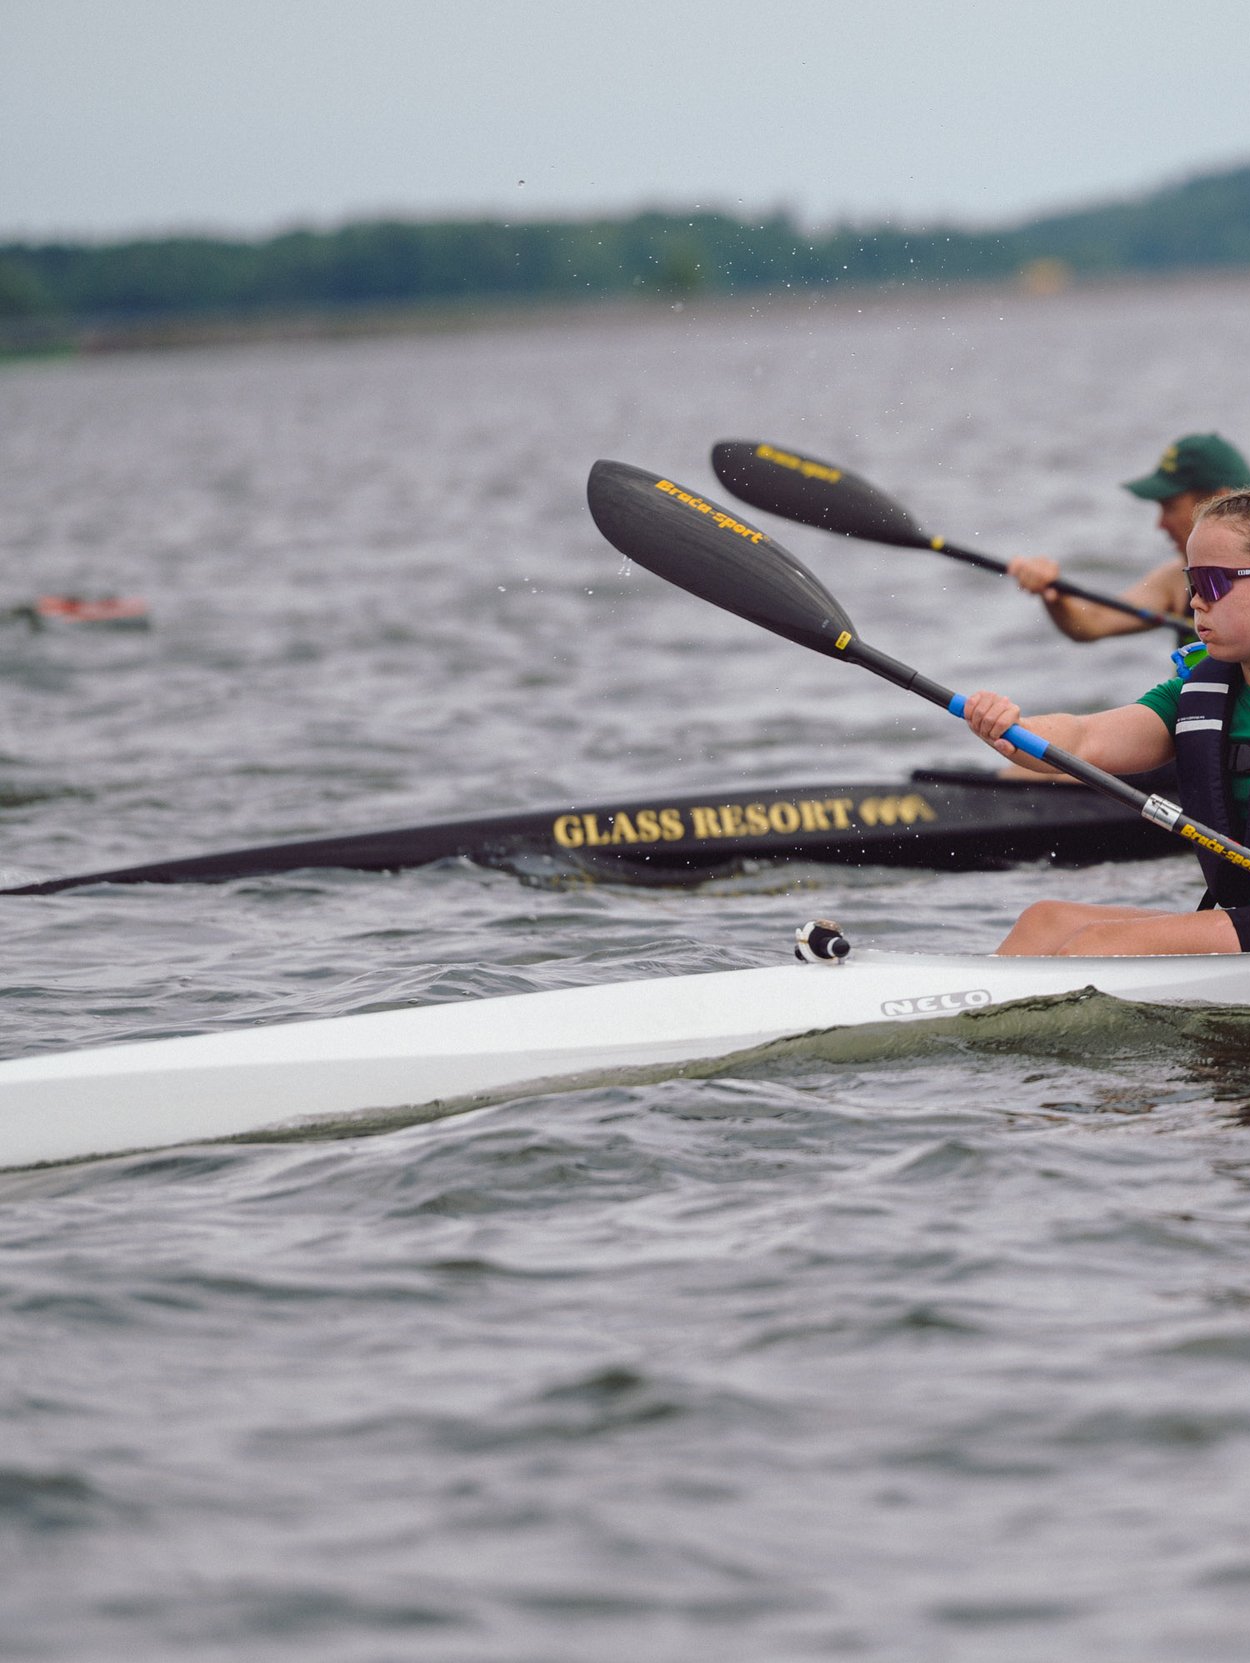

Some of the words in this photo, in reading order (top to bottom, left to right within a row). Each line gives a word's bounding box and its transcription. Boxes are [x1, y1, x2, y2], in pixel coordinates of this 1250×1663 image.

[553, 807, 685, 848] GLASS
[693, 798, 854, 840] RESORT
[883, 990, 990, 1016] NELO
